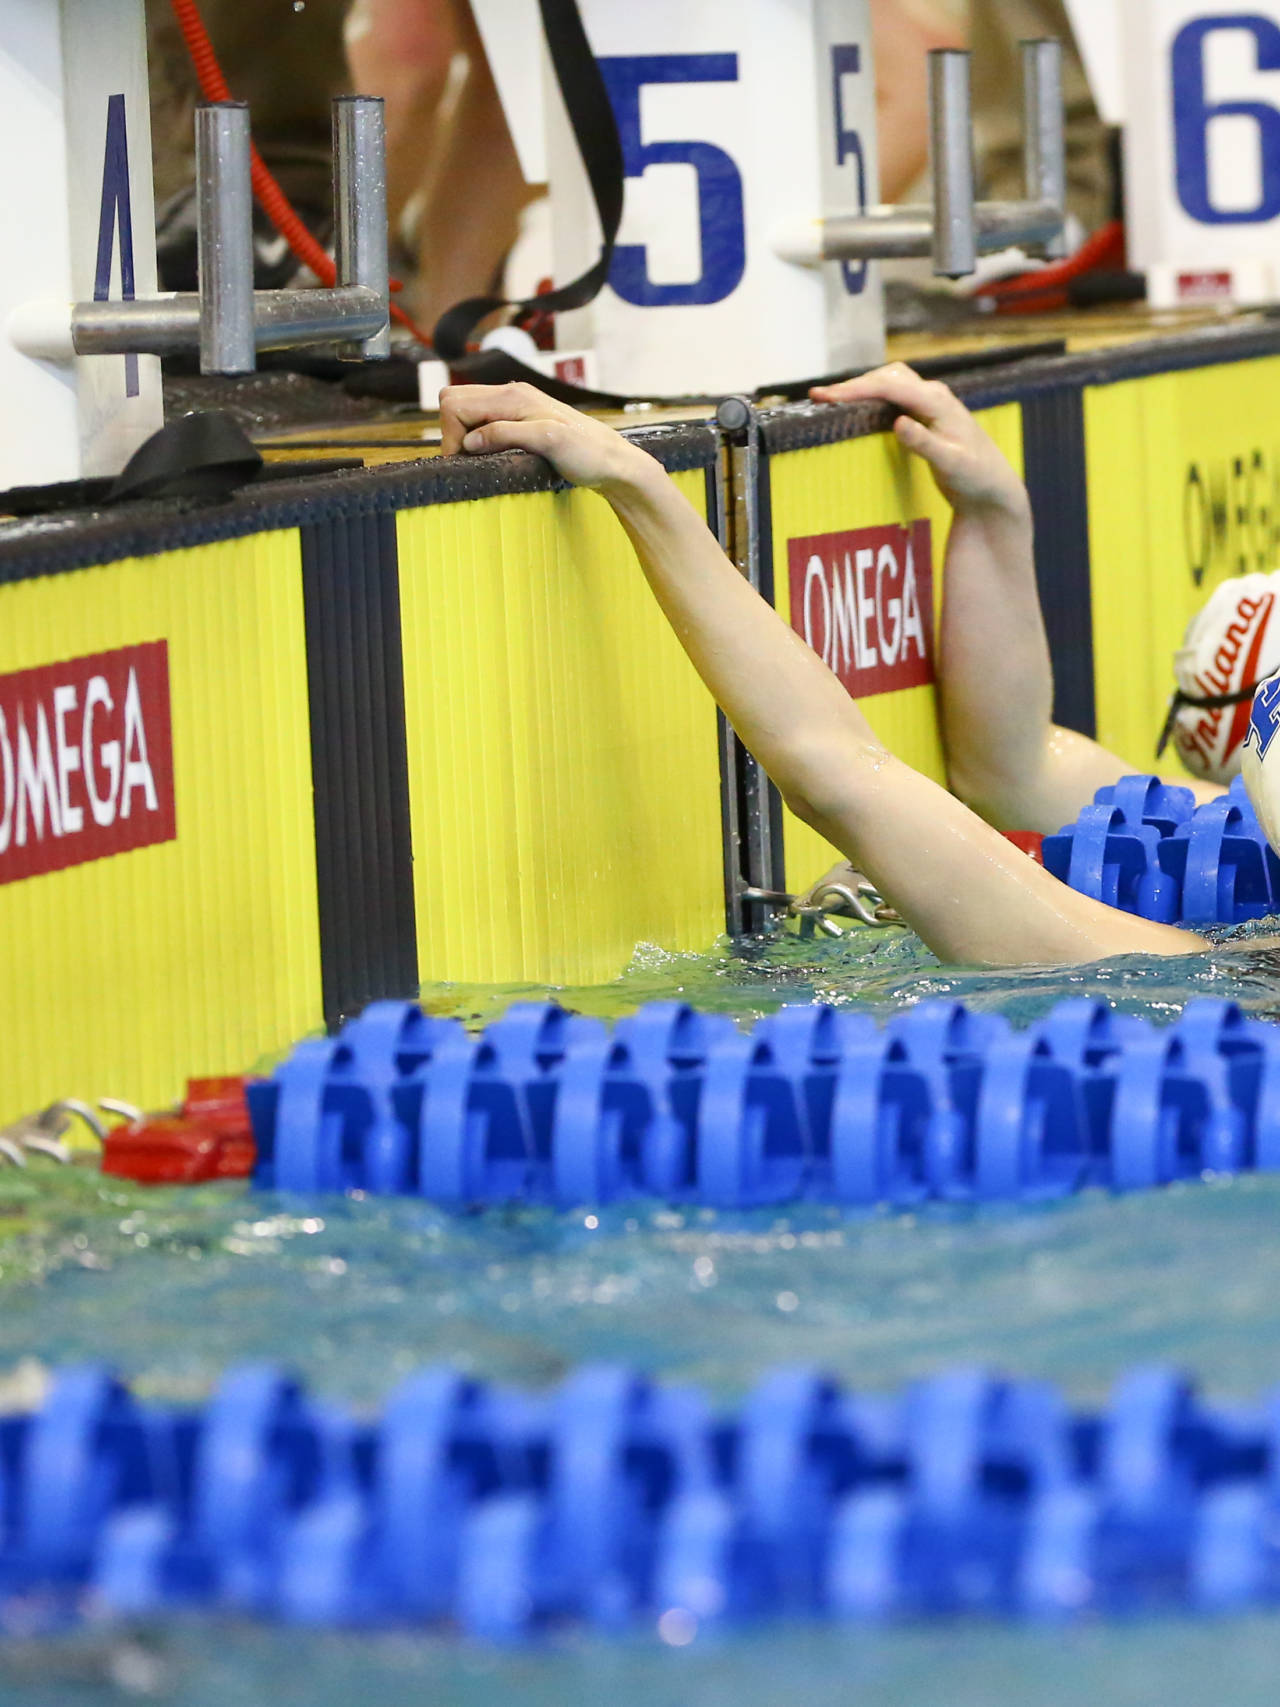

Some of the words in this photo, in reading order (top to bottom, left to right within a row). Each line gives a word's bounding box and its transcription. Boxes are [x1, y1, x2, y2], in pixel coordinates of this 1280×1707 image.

[594, 52, 746, 307] 5
[830, 43, 868, 295] 5
[804, 541, 926, 675] OMEGA
